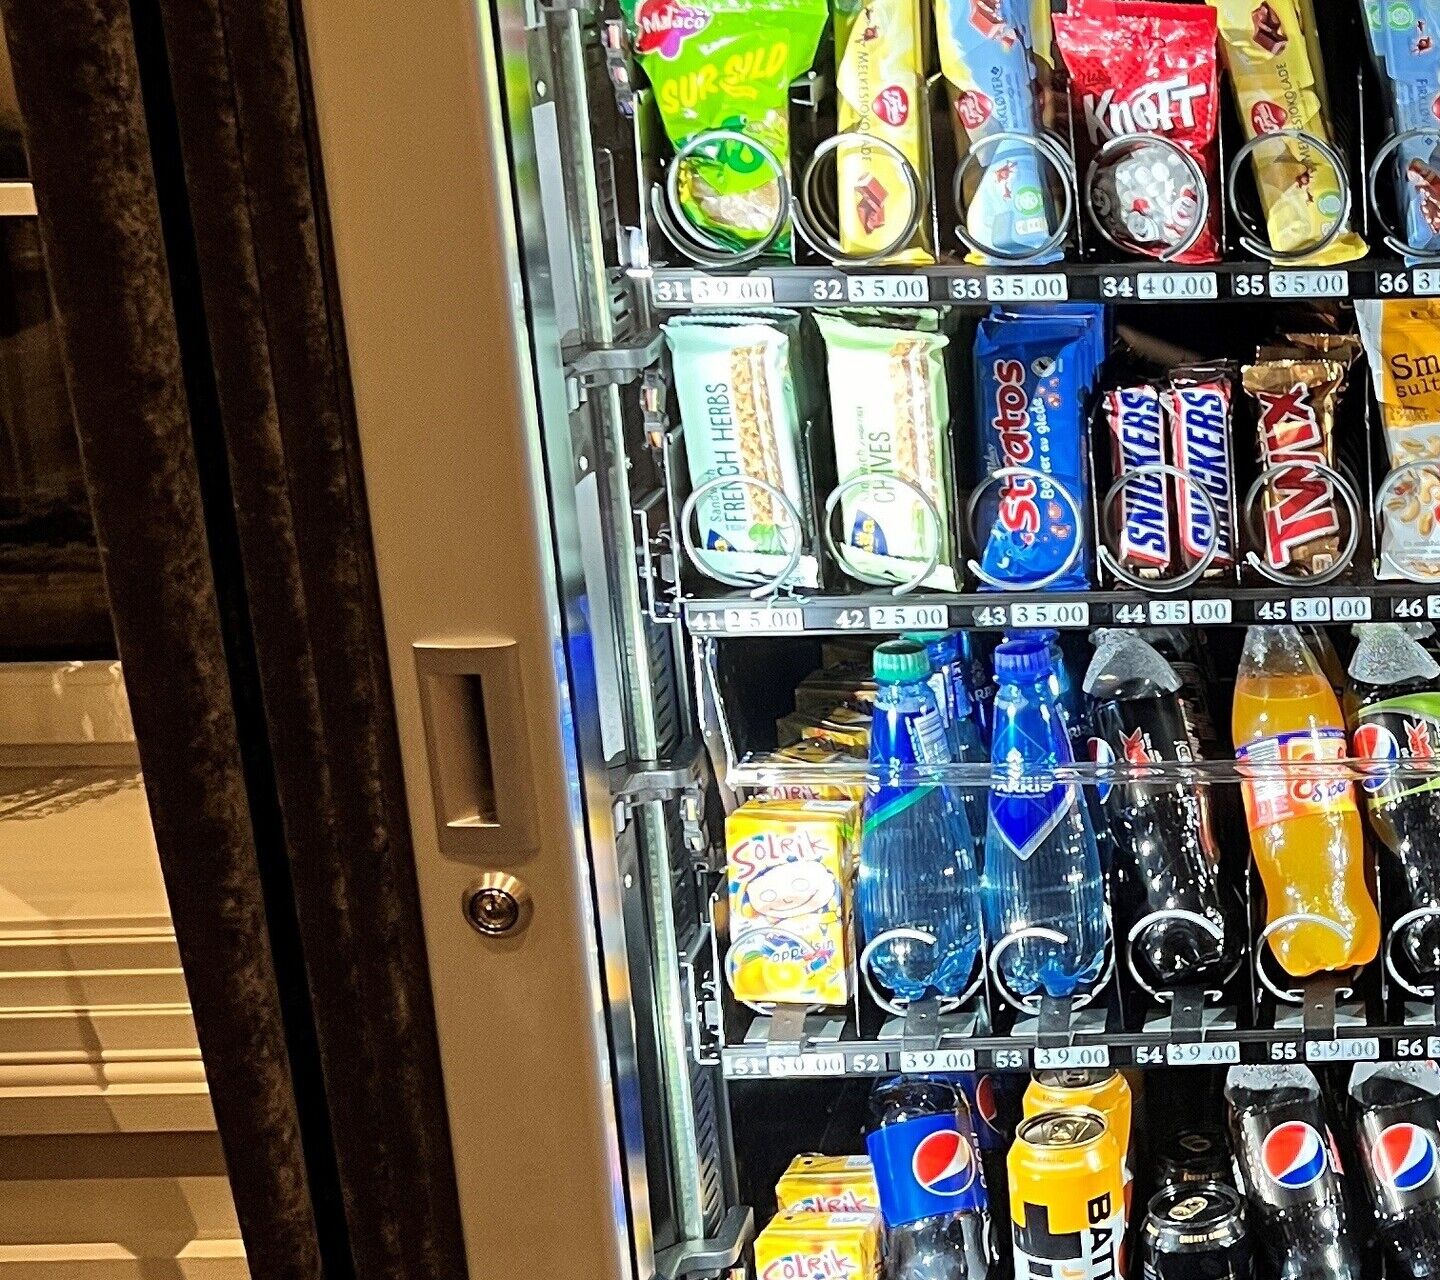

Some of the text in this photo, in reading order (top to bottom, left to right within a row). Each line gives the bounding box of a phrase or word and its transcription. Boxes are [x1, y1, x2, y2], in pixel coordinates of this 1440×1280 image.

[661, 64, 720, 114] SUR
[657, 282, 687, 301] 31
[814, 279, 924, 300] 32 35.00
[952, 279, 1063, 299] 33 35.00
[1103, 276, 1213, 297] 34 40.00
[1236, 274, 1344, 295] 35 35.00
[1379, 273, 1408, 293] 36
[705, 382, 735, 442] HERBS
[1120, 390, 1168, 554] SNICKERS
[1180, 390, 1231, 557] SNICKERS
[1256, 382, 1341, 569] TWIX
[835, 608, 944, 628] 42 25.00
[978, 604, 1084, 625] 43 35.00
[1115, 602, 1228, 624] 44 35.00
[1258, 599, 1367, 620] 45 30.00
[1395, 600, 1424, 618] 46
[692, 611, 721, 629] 41
[995, 1049, 1106, 1068] 53 39.00
[1136, 1044, 1236, 1064] 54 39.00
[1271, 1041, 1376, 1060] 55 39.00
[1397, 1040, 1424, 1057] 56
[735, 1058, 762, 1075] 51
[853, 1052, 971, 1072] 52 39.00
